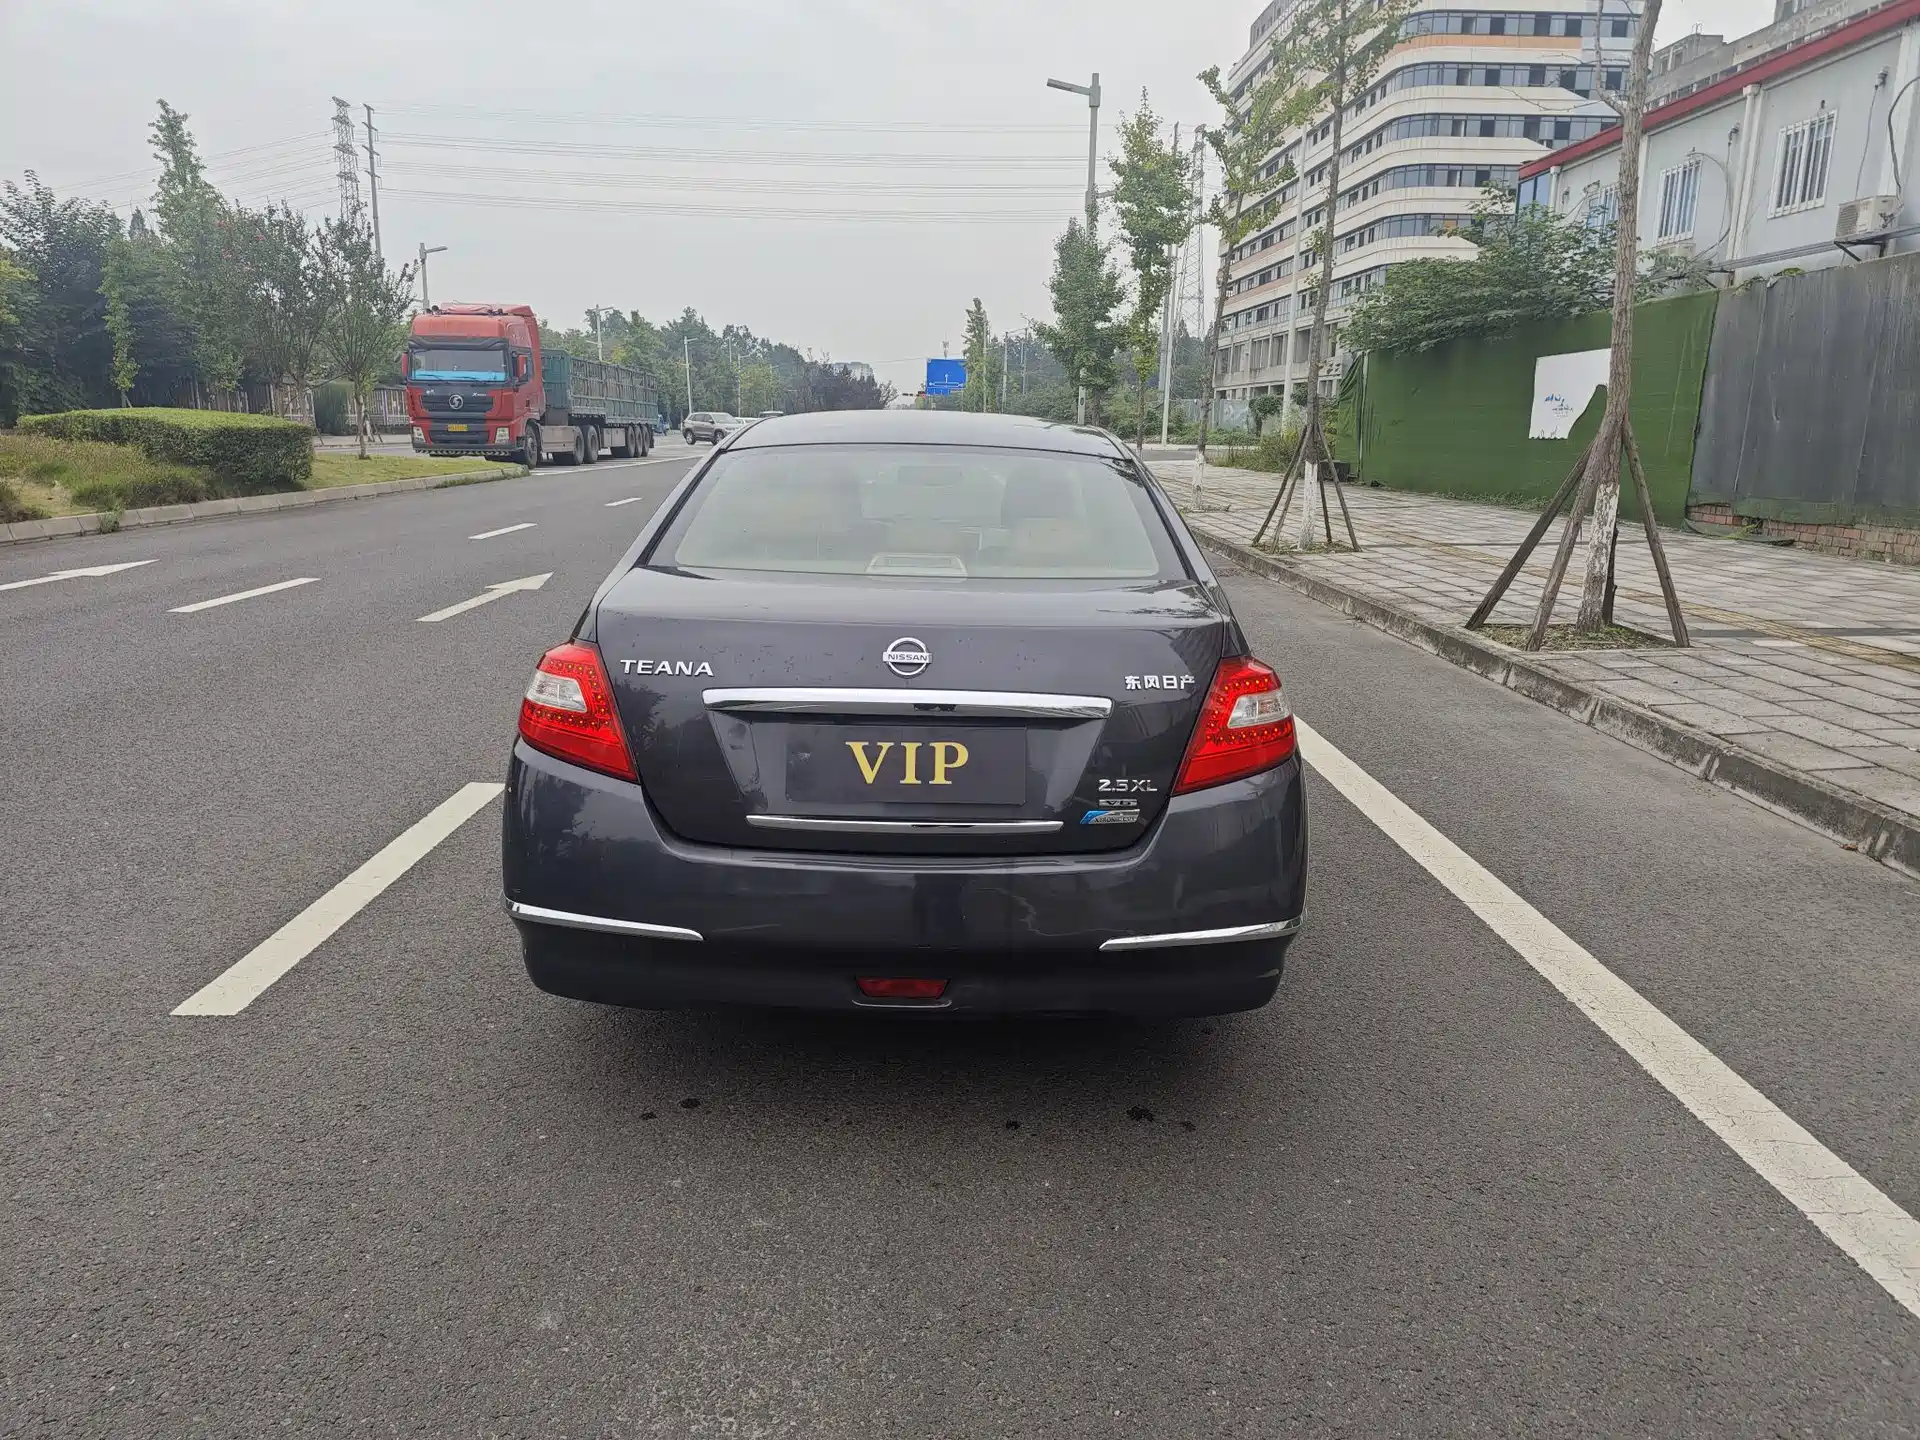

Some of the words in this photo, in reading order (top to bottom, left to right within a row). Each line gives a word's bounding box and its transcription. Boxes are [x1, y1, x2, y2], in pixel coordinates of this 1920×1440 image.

[888, 653, 928, 661] NISSAN
[620, 659, 714, 677] TEANA
[1124, 674, 1195, 690] 东风日产
[845, 741, 969, 785] VIP
